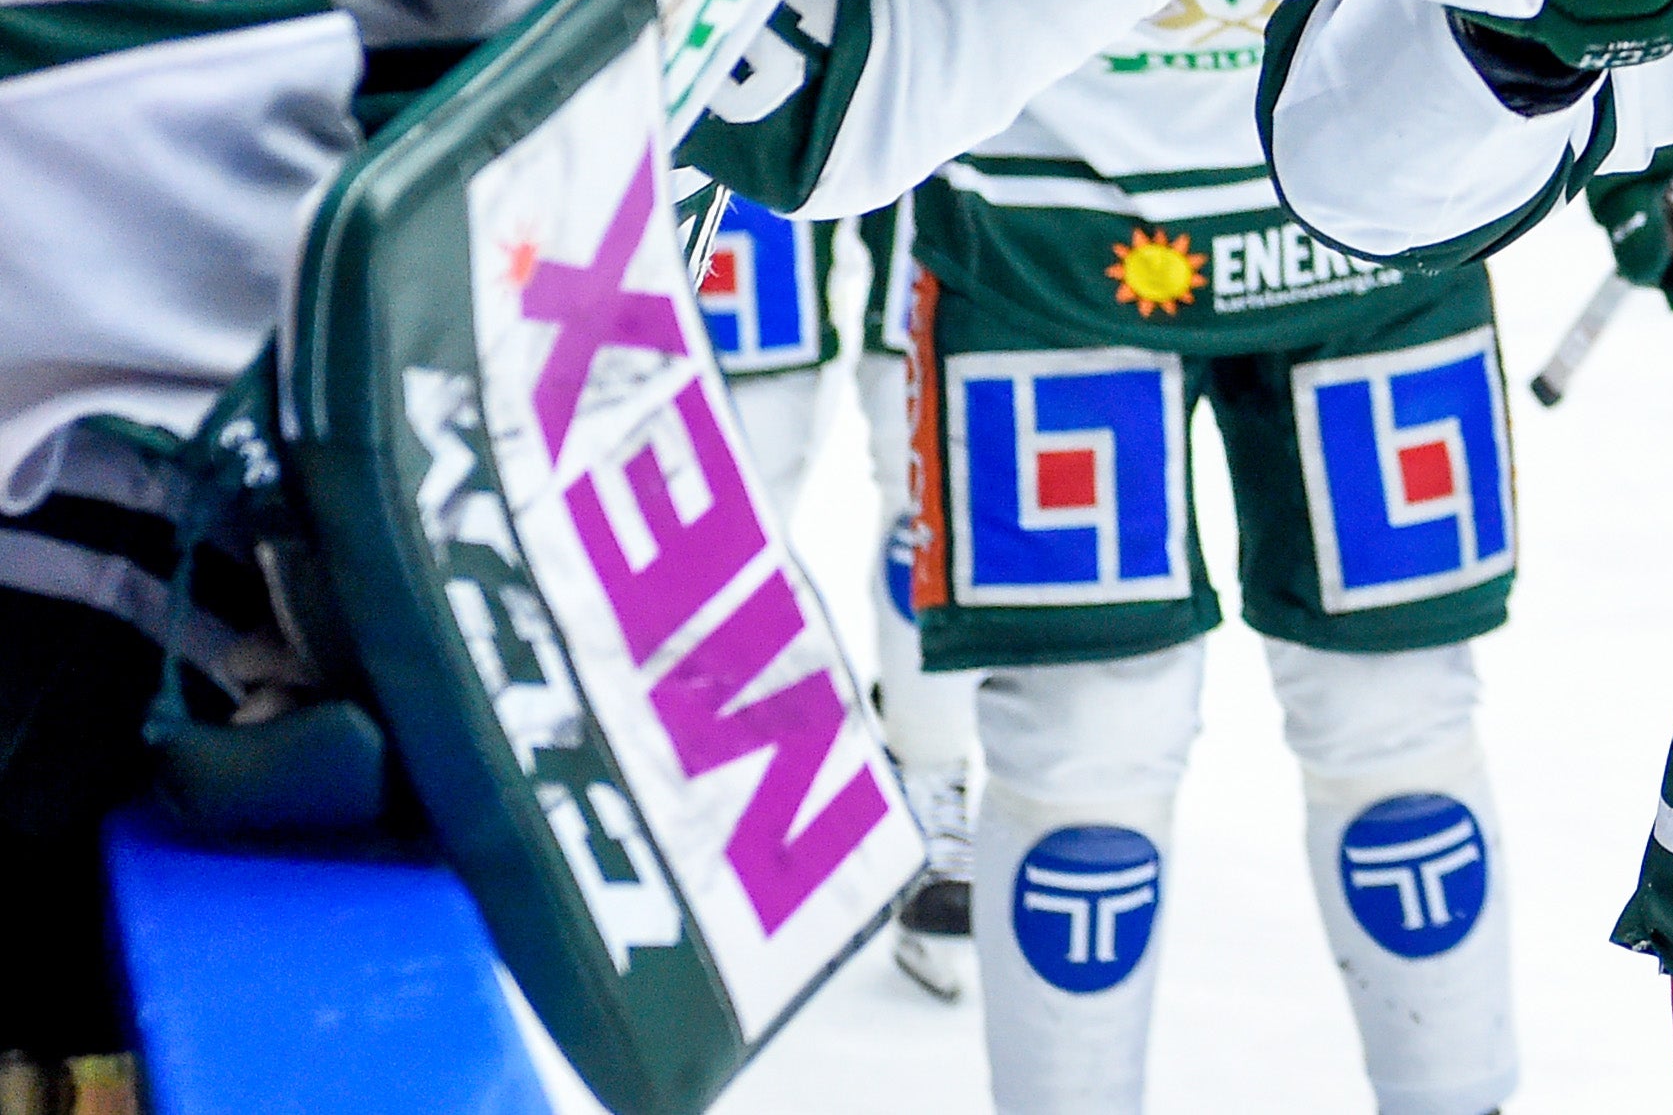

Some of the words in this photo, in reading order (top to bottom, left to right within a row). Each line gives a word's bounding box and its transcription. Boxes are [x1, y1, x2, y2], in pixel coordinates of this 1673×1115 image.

[520, 132, 891, 942] MEX
[1211, 222, 1386, 297] ENER
[402, 365, 687, 977] CCM
